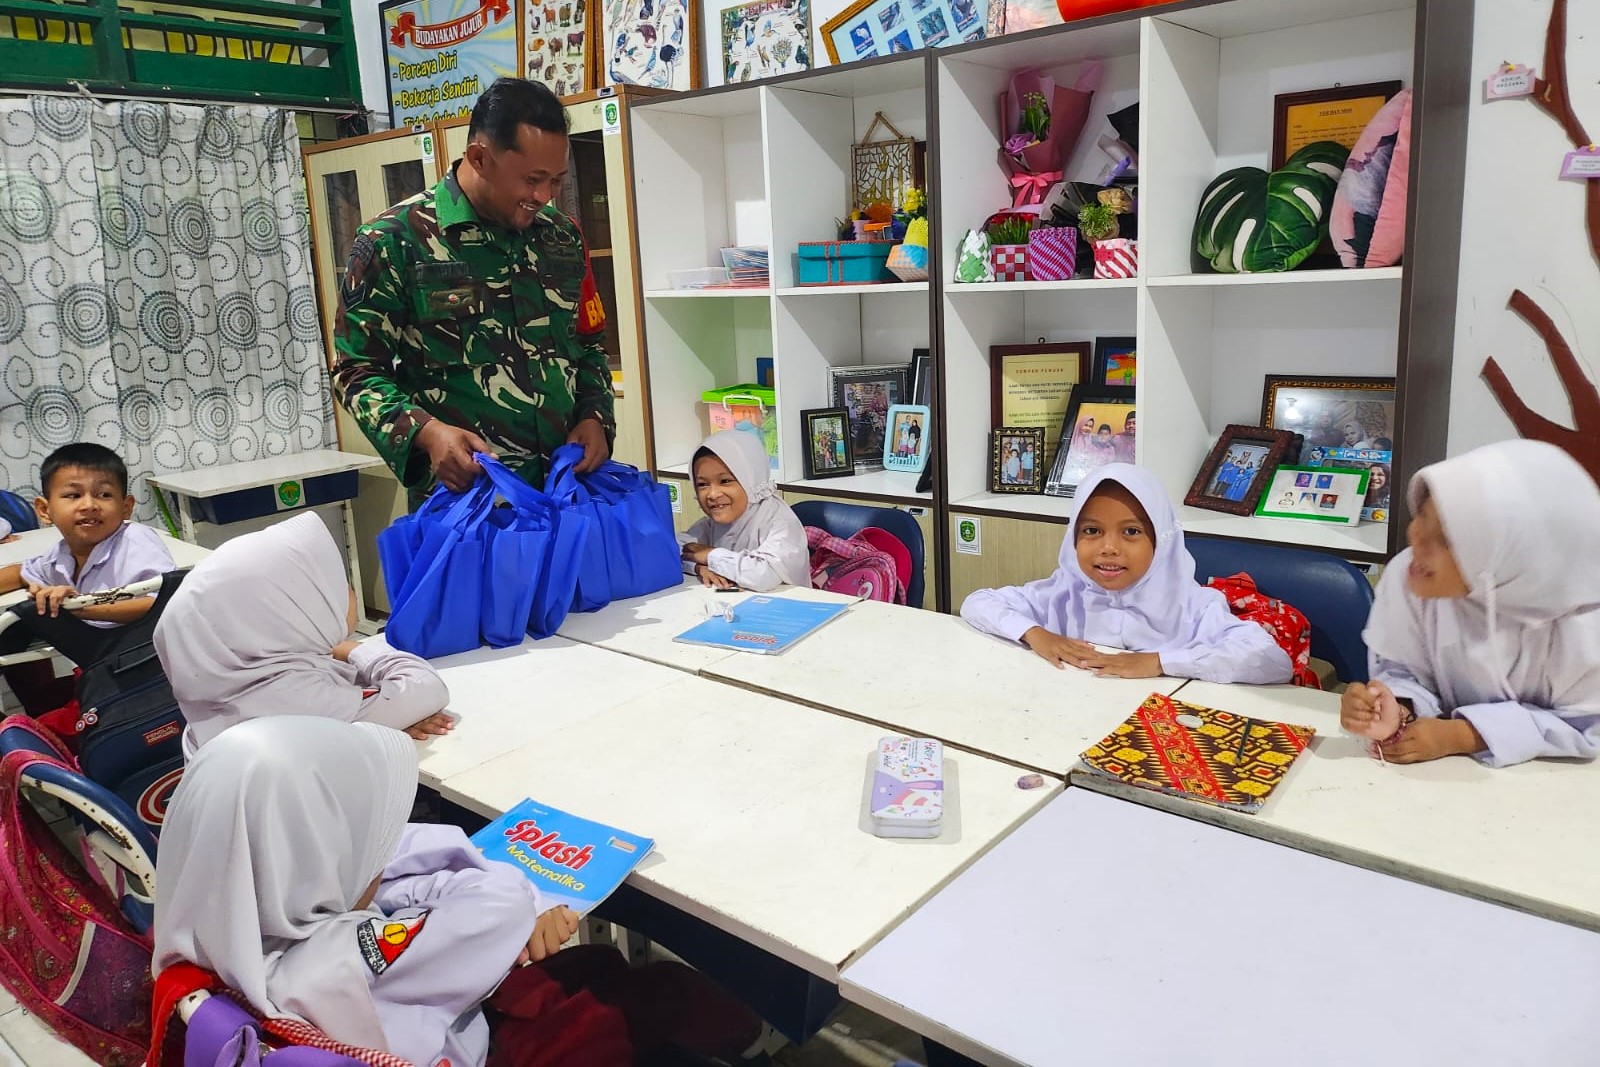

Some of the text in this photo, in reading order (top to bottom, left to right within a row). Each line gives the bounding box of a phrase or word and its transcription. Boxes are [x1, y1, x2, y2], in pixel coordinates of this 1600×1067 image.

[415, 14, 483, 44] BUDAYAKAN JUJUR
[399, 59, 437, 81] Percaya
[438, 50, 458, 73] Diri
[401, 85, 440, 109] Bekerja
[442, 75, 479, 101] Sendiri
[504, 819, 596, 871] Splash
[507, 844, 586, 892] Matematika
